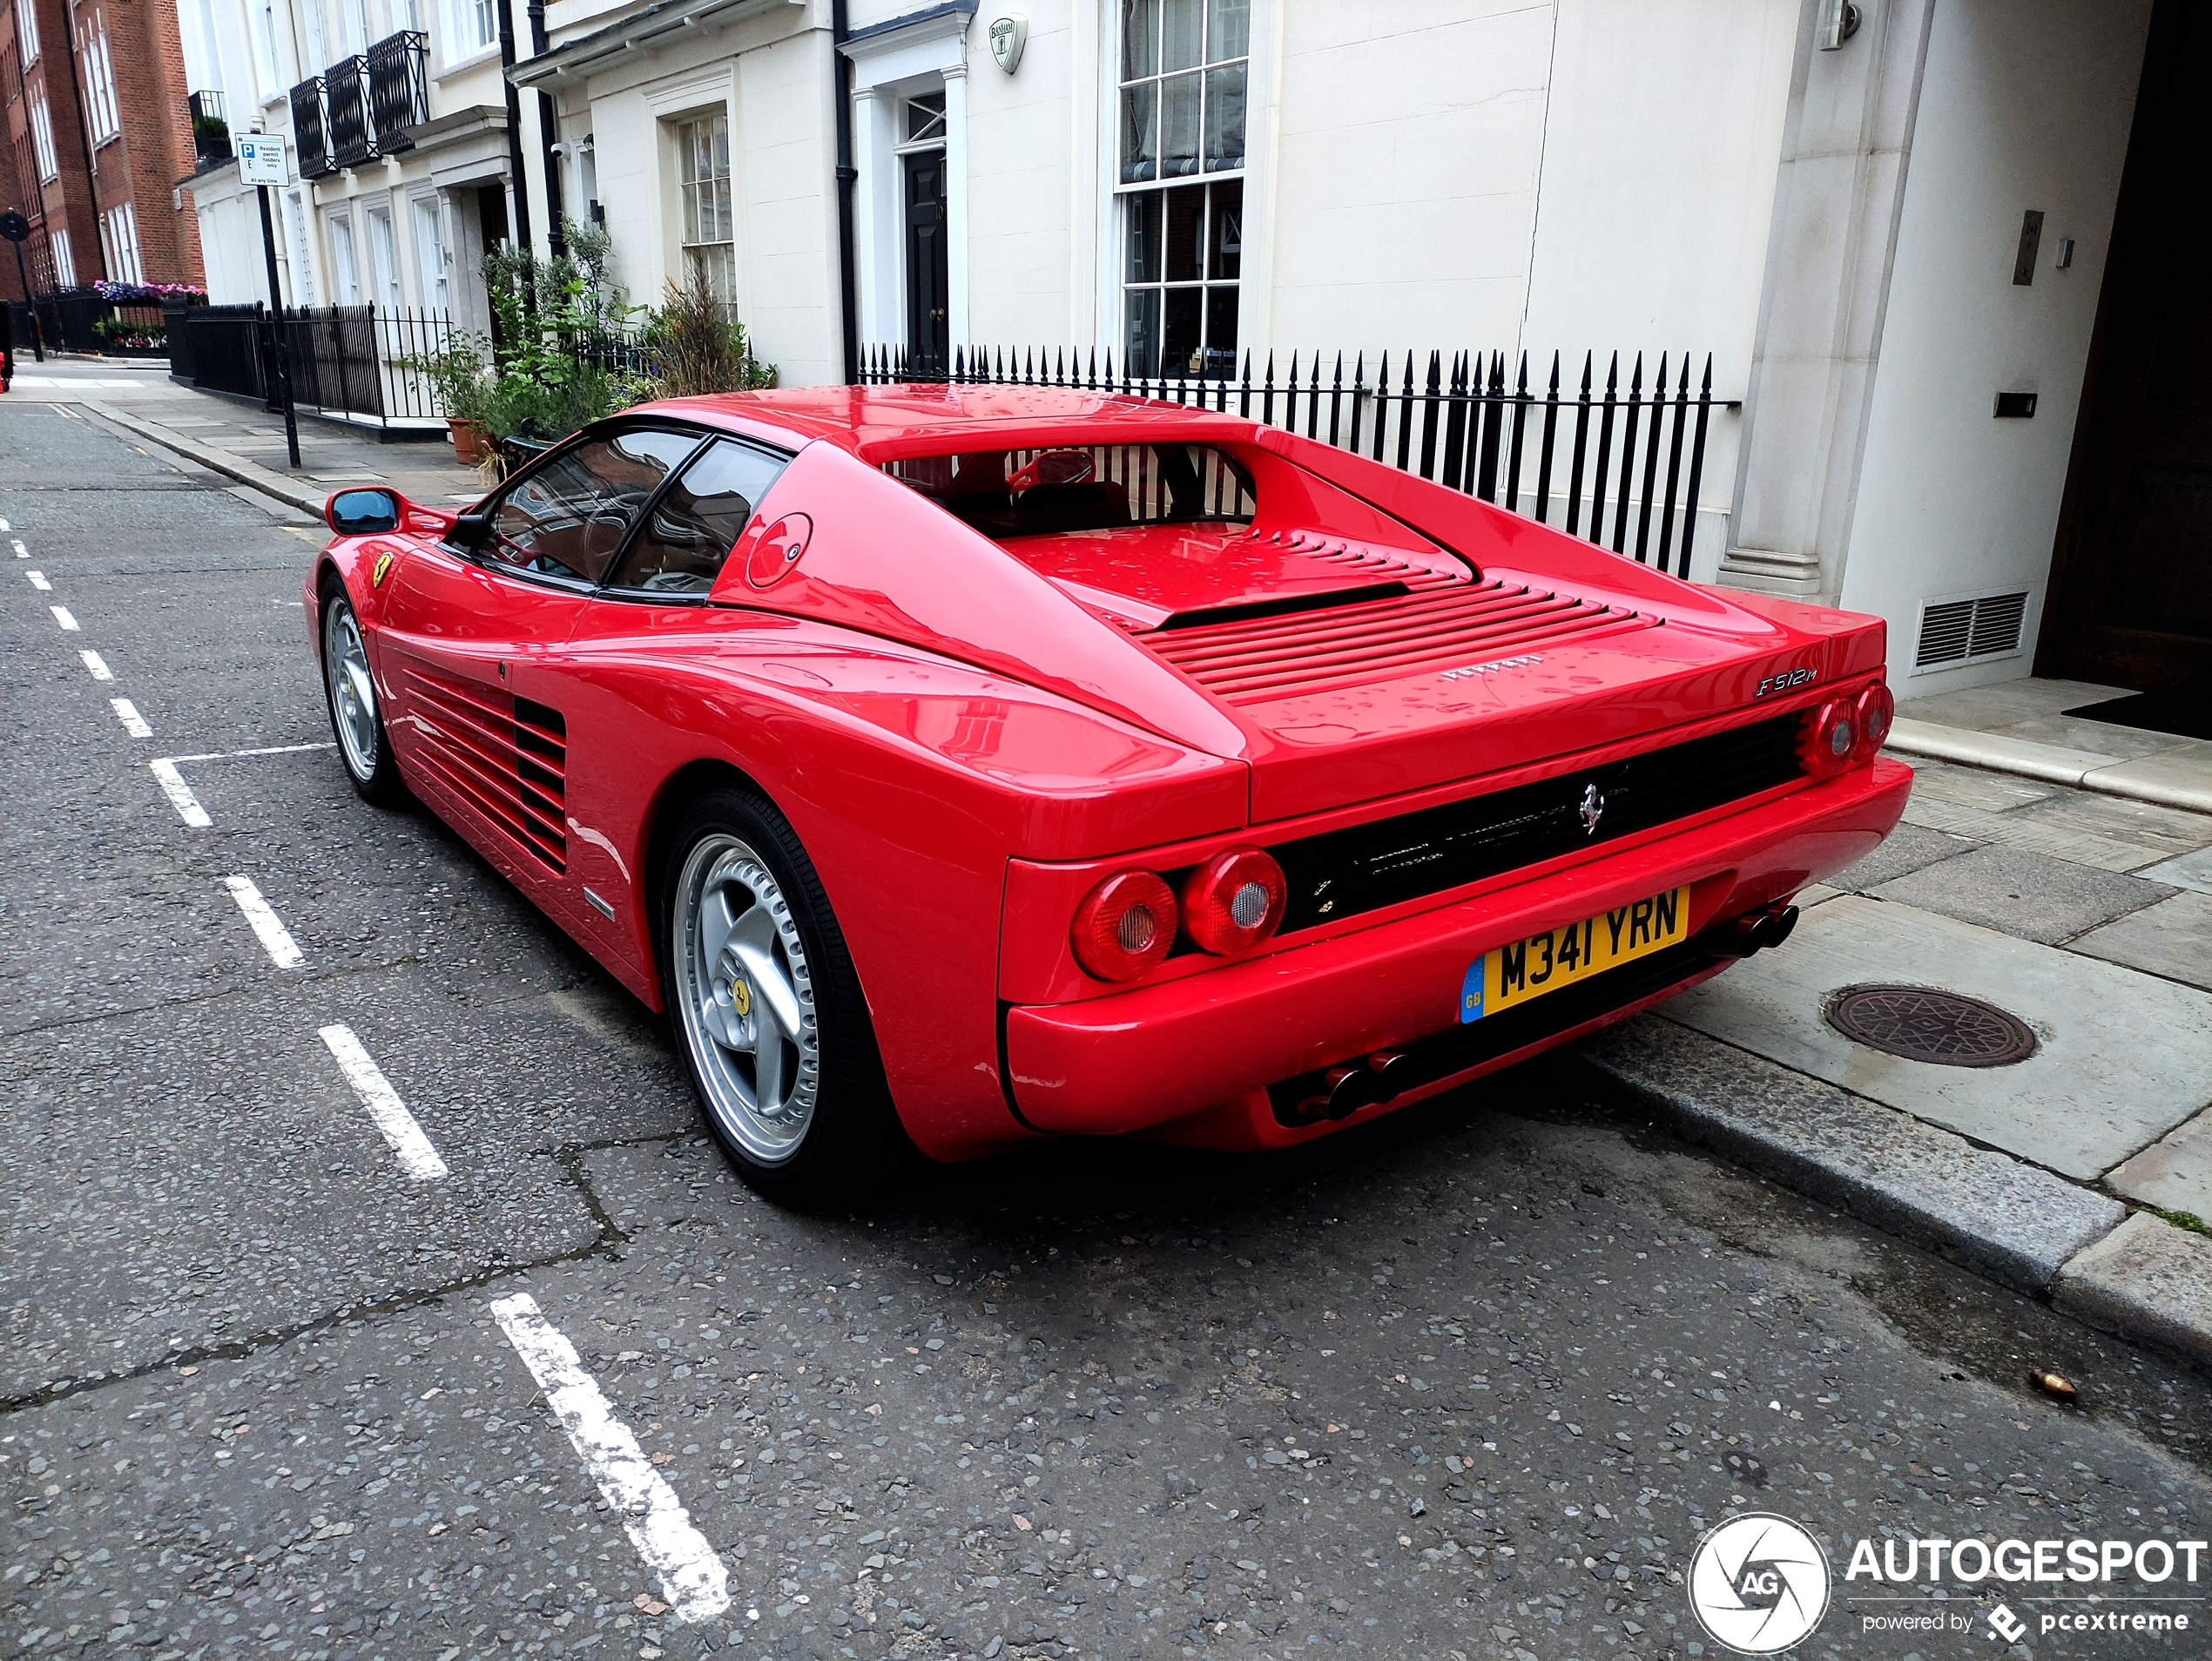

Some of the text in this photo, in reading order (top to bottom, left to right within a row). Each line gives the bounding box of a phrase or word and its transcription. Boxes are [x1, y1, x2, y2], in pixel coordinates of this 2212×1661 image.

[991, 23, 1013, 39] BANHAM
[243, 145, 253, 158] P
[247, 159, 253, 169] E
[1501, 888, 1679, 998] M341 YRN
[1466, 991, 1480, 1009] GB
